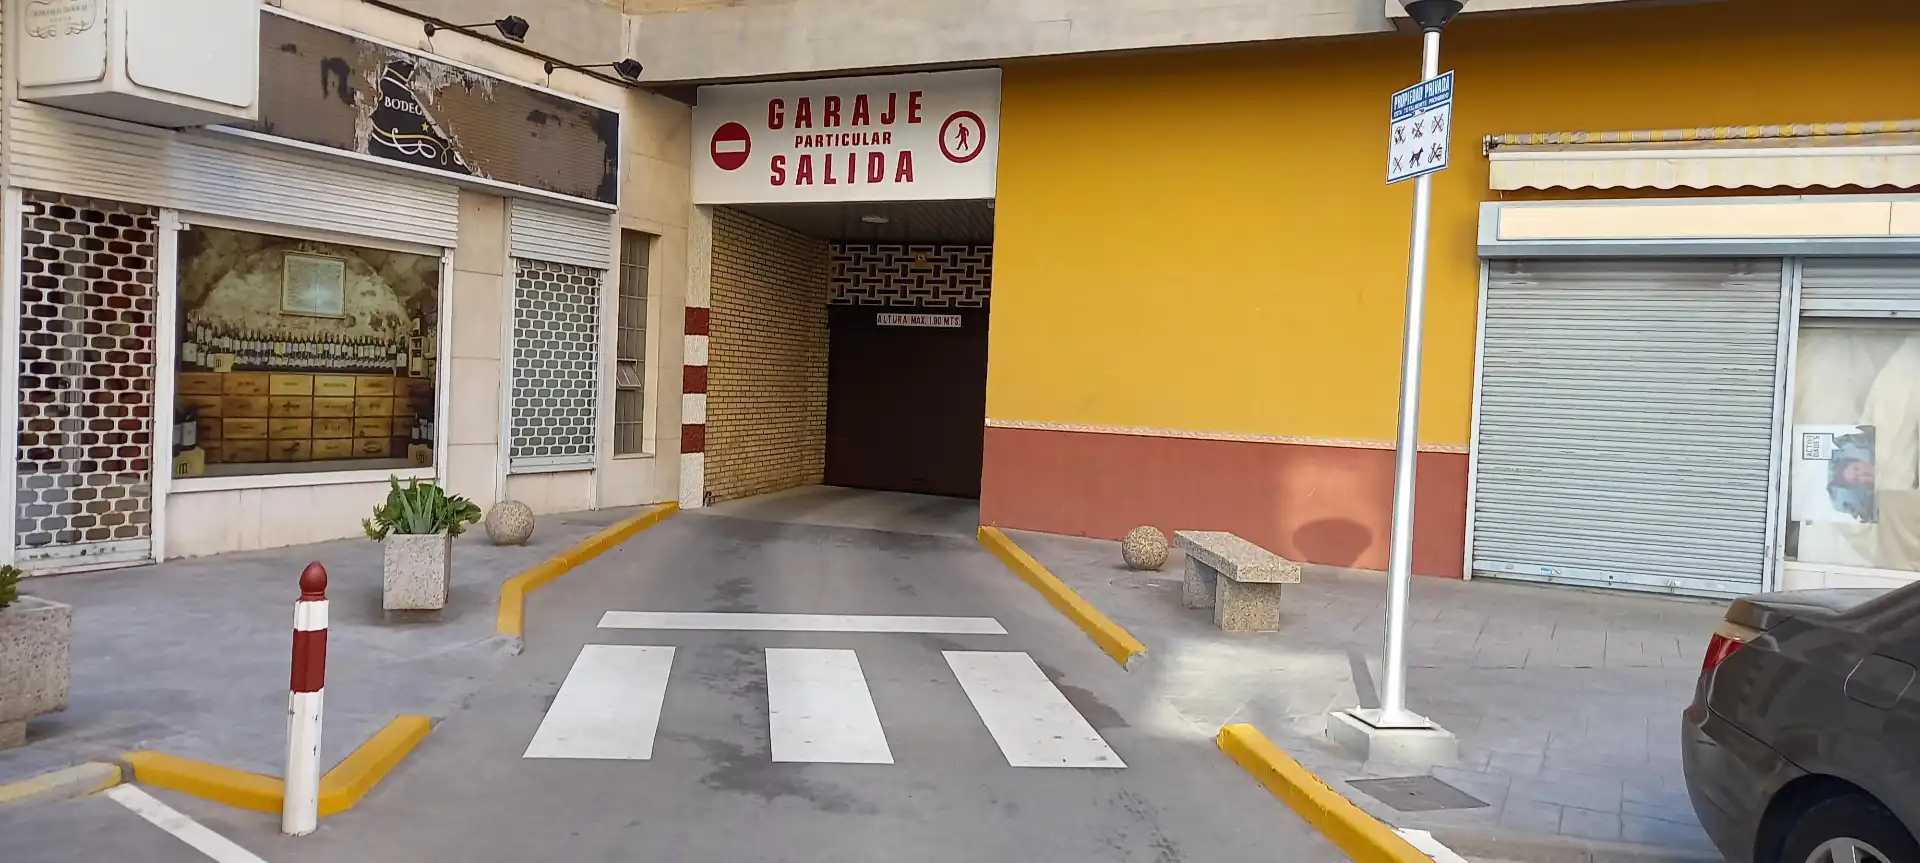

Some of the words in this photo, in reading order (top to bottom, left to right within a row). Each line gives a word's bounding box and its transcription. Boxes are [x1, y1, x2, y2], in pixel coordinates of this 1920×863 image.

[768, 91, 923, 130] GARAJE
[1394, 86, 1424, 111] PROPIEDAD
[1425, 75, 1450, 99] PRIVADA
[795, 131, 892, 148] PARTICULAR
[770, 150, 914, 186] SALIDA
[877, 314, 908, 325] ALTURA
